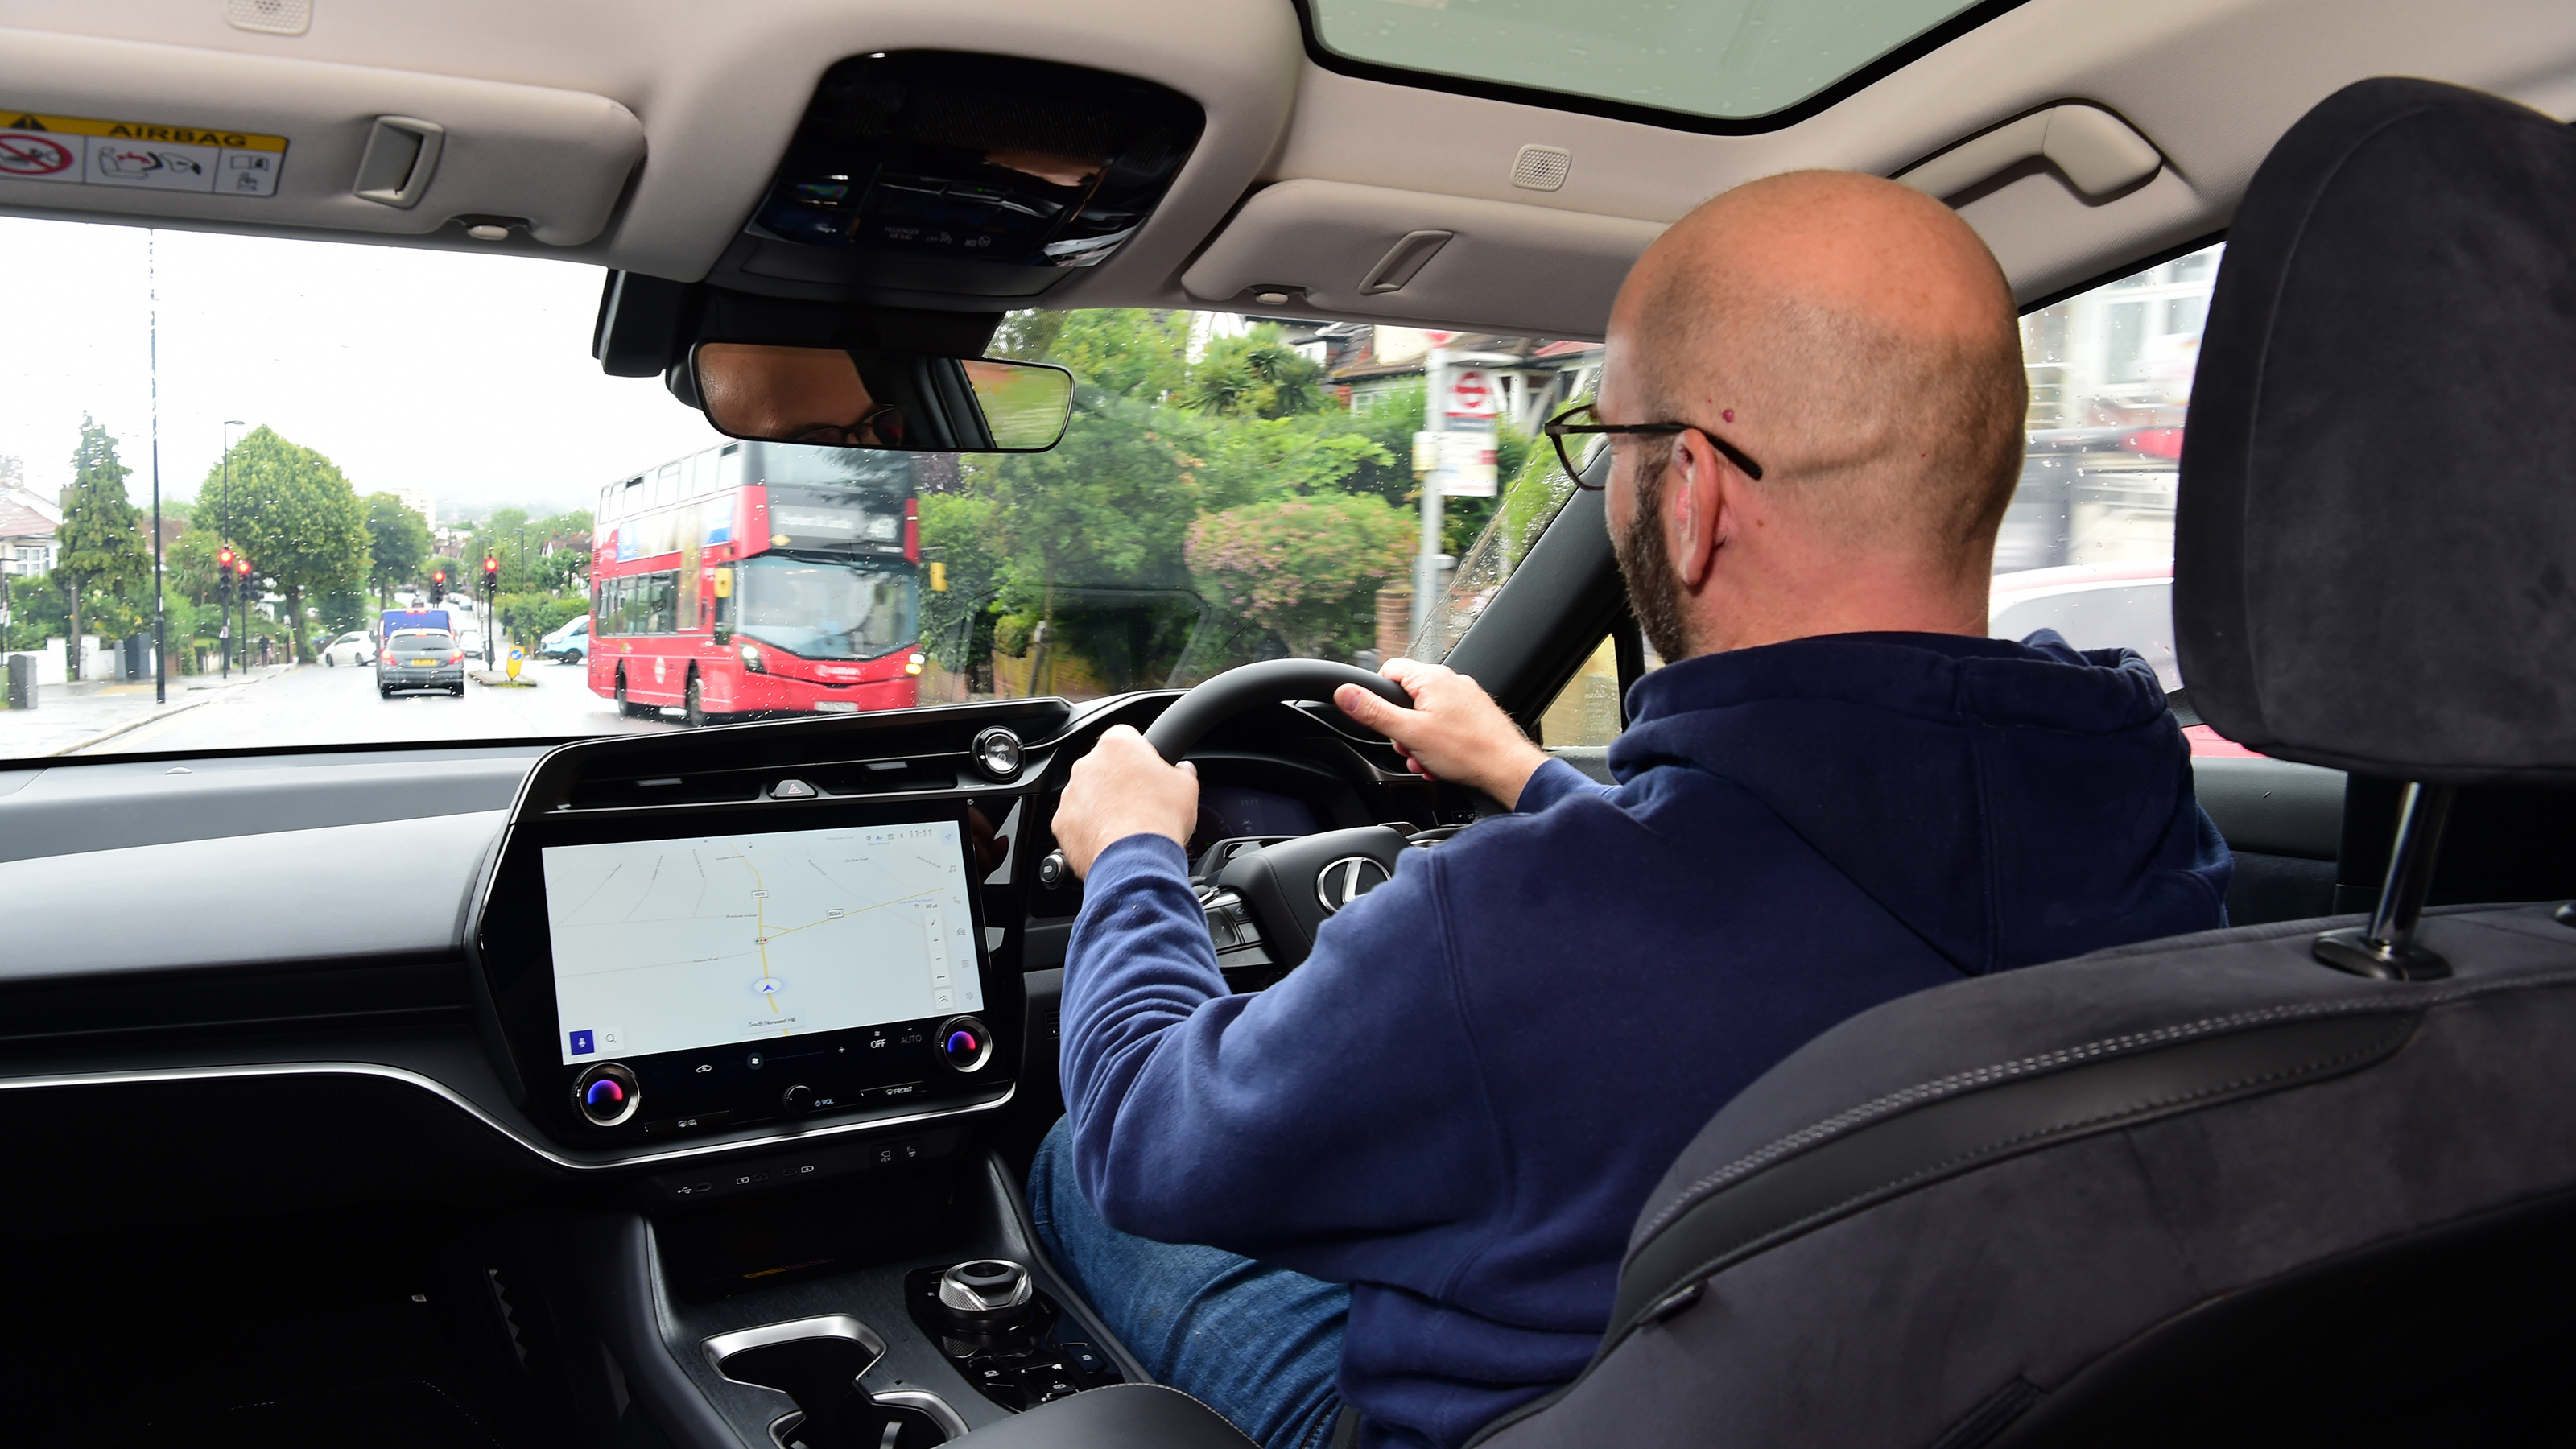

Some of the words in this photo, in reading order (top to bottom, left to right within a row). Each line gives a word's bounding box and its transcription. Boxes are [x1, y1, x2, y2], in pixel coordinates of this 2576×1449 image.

[109, 124, 247, 147] AIRBAG
[885, 226, 920, 235] PASSENGER
[909, 828, 932, 838] 11:11
[870, 1038, 886, 1048] OFF
[901, 1034, 923, 1045] AUTO
[894, 1086, 912, 1094] FRONT
